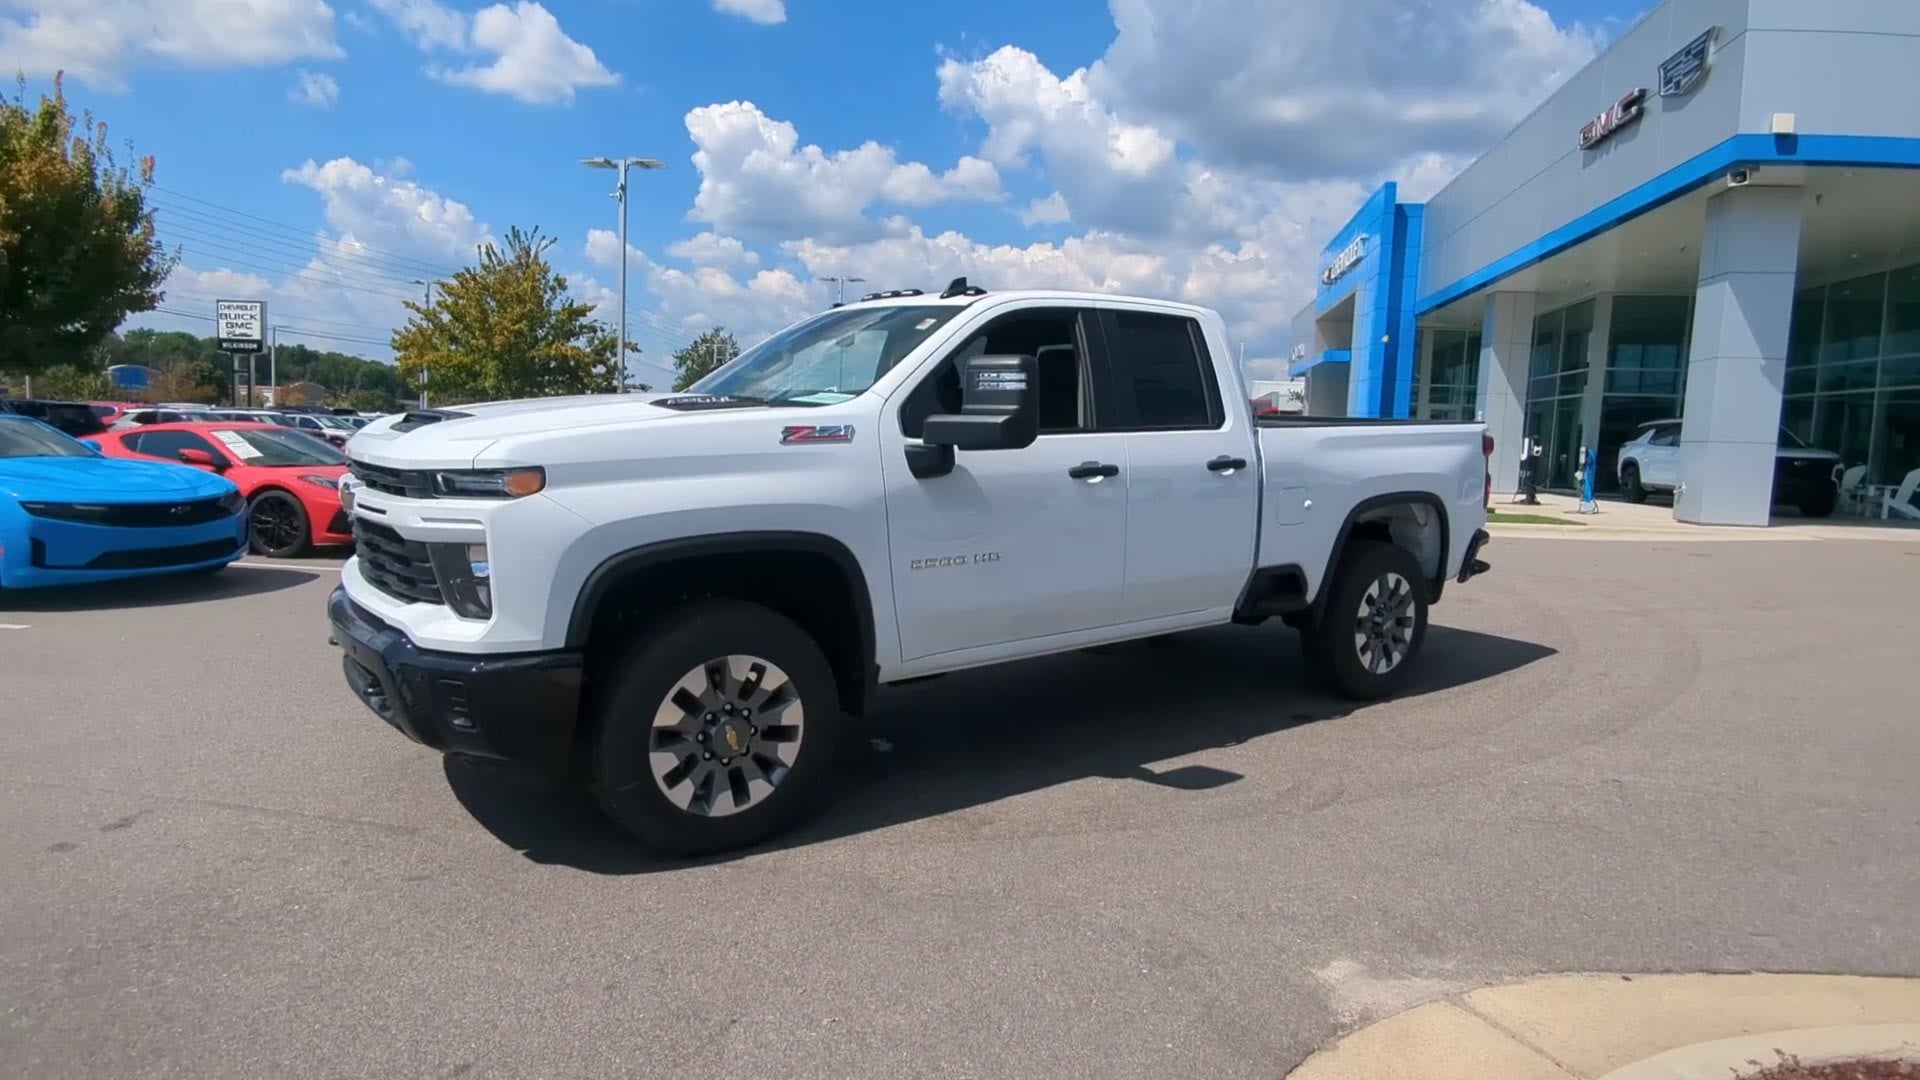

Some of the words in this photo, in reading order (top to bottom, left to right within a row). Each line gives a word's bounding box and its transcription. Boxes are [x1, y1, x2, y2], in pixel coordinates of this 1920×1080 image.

[1579, 87, 1640, 149] GMC
[219, 303, 258, 311] CHEVROLET
[219, 312, 258, 321] BUICK
[225, 321, 253, 330] GMC
[222, 342, 258, 350] WILKINSON
